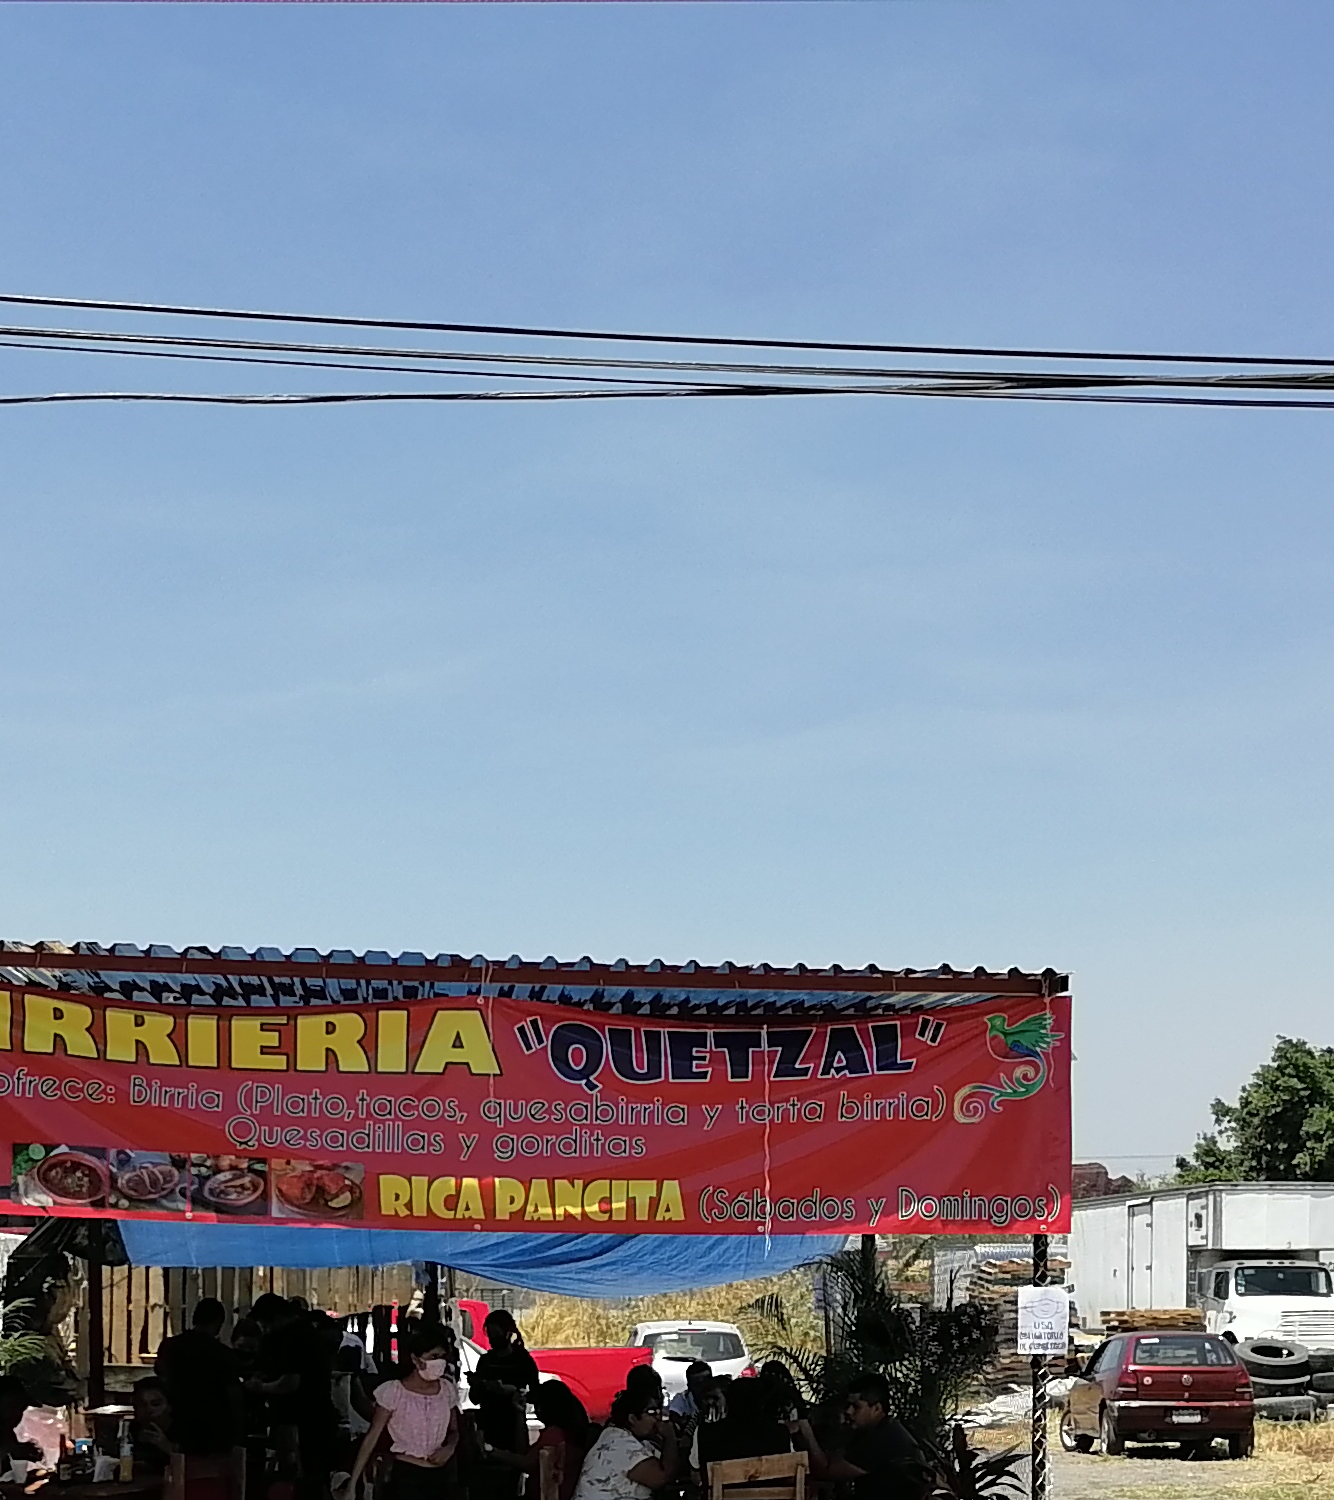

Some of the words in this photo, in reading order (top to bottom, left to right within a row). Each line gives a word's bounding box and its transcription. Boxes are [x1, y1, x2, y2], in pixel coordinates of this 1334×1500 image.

[514, 1015, 946, 1093] "QUETZAL"
[130, 1075, 223, 1112] Birria
[480, 1091, 688, 1128] quesabirria
[702, 1104, 723, 1130] y
[736, 1097, 825, 1124] torta
[838, 1085, 947, 1122] birria)
[226, 1115, 445, 1153] Quesadillas
[460, 1133, 479, 1160] y
[493, 1126, 647, 1161] gorditas
[378, 1173, 486, 1220] RICA
[494, 1176, 685, 1222] PANCITA
[699, 1186, 857, 1223] (Sábados
[868, 1195, 887, 1227] y
[897, 1184, 1062, 1226] Domingos)
